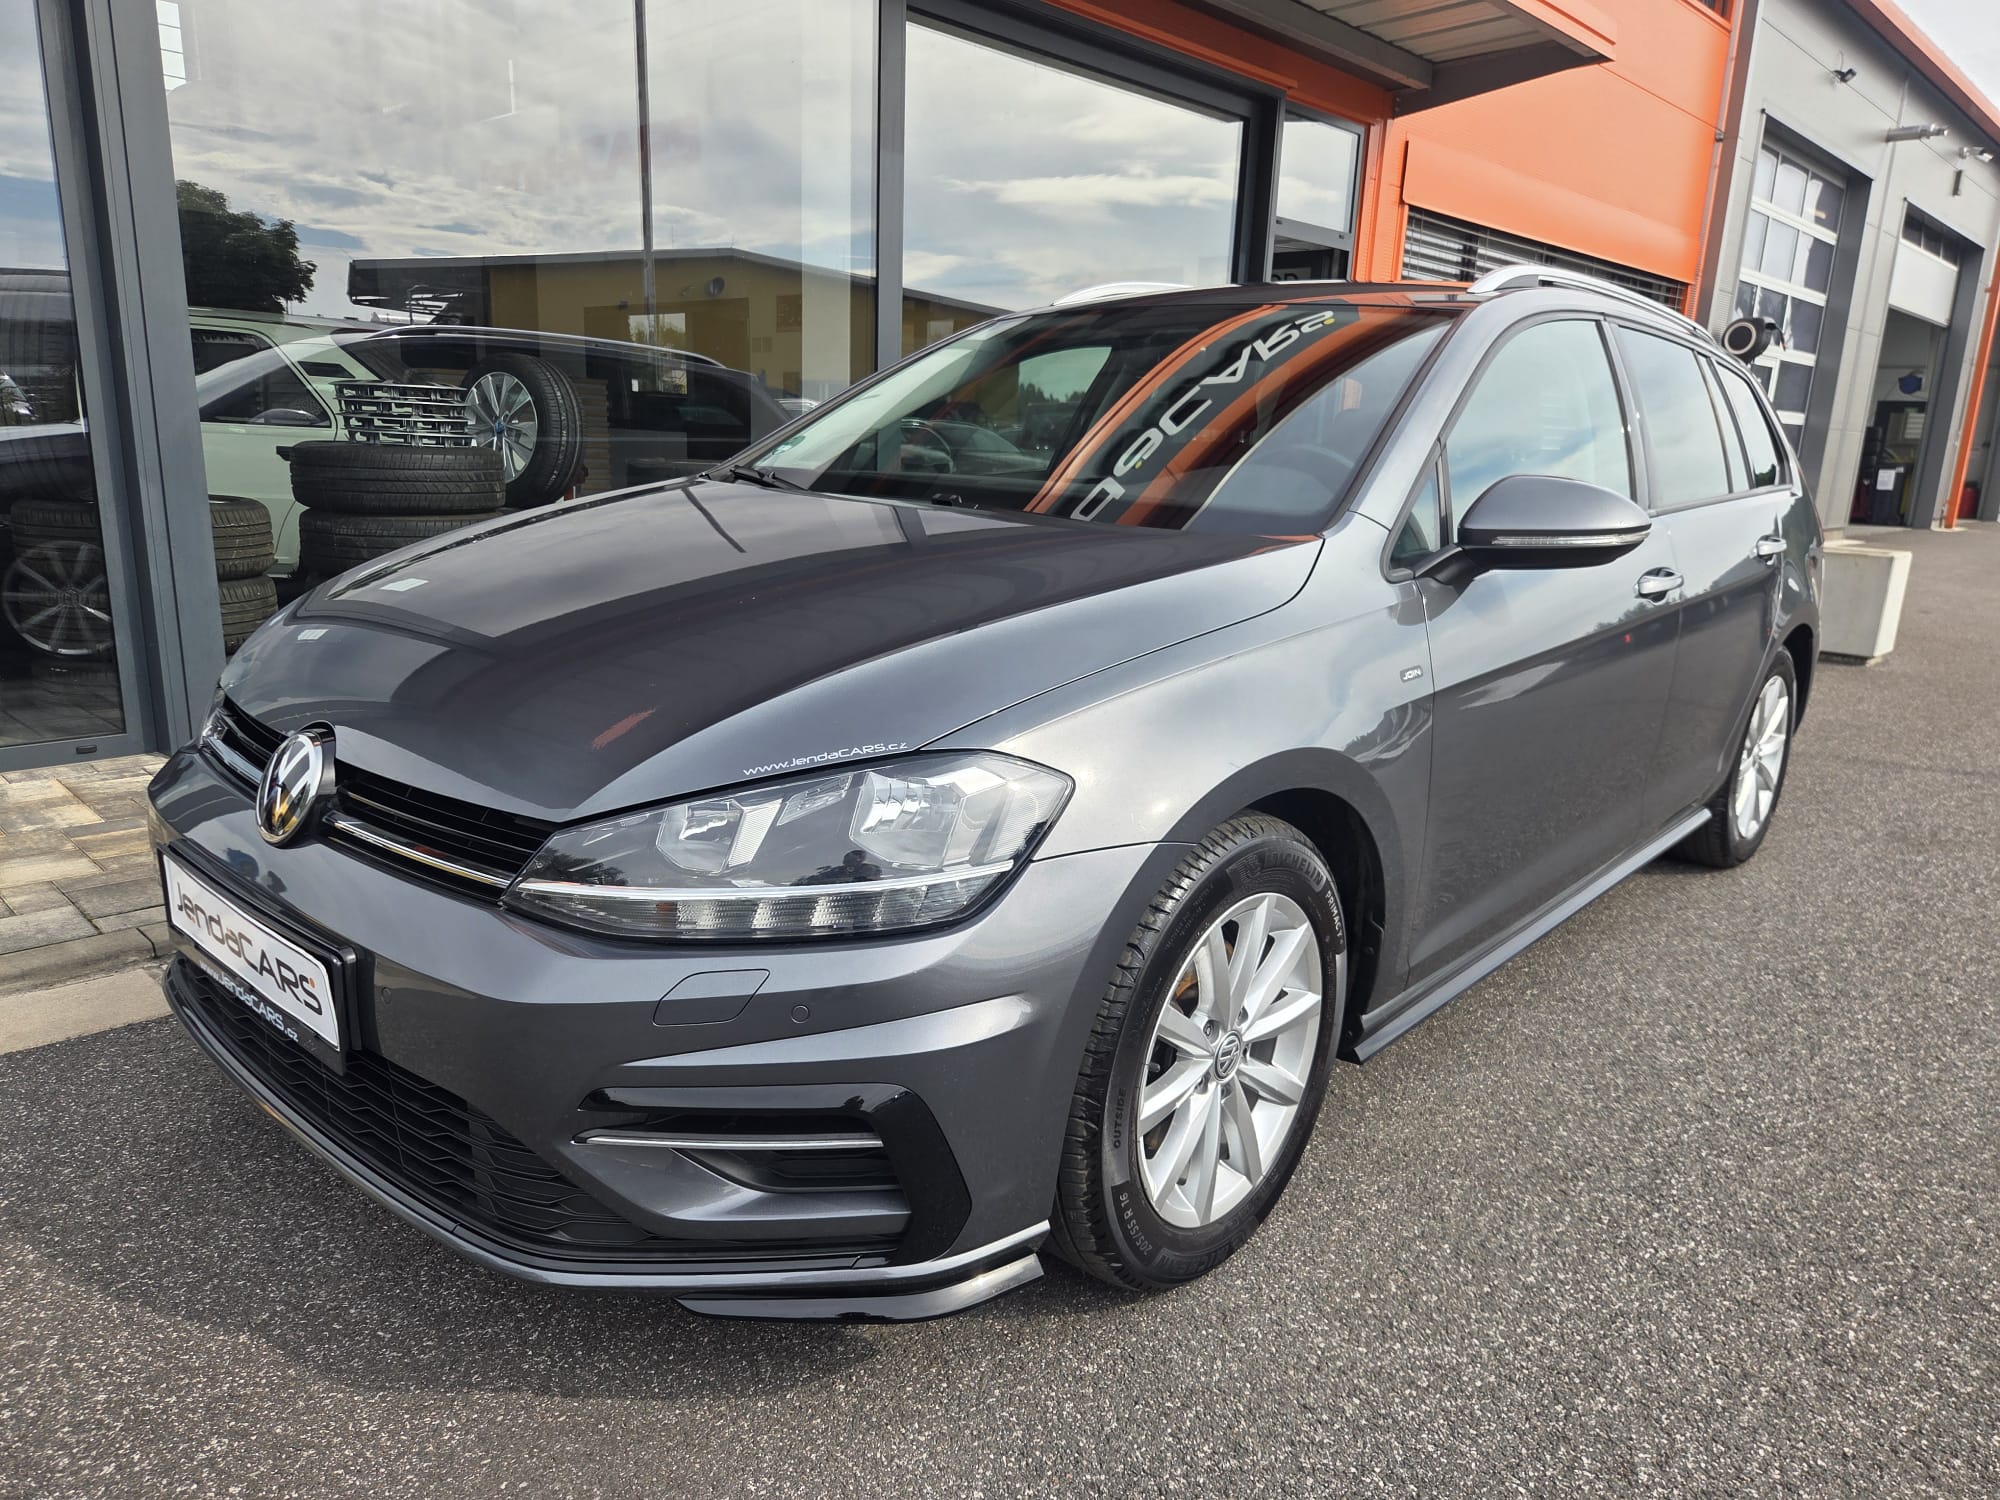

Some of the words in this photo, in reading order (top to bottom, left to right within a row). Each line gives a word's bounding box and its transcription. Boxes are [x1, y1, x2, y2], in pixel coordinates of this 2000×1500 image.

[1402, 668, 1422, 680] JOIN
[743, 742, 908, 776] www.JendaCARS.cz
[1324, 889, 1343, 937] PRIMACY
[176, 881, 323, 1016] JendaCARS
[200, 963, 299, 1042] www.JendaCARS.cz
[1113, 1087, 1126, 1149] OUTSIDE
[1119, 1191, 1129, 1208] 16
[1124, 1208, 1134, 1220] R
[1127, 1220, 1153, 1256] 205/55
